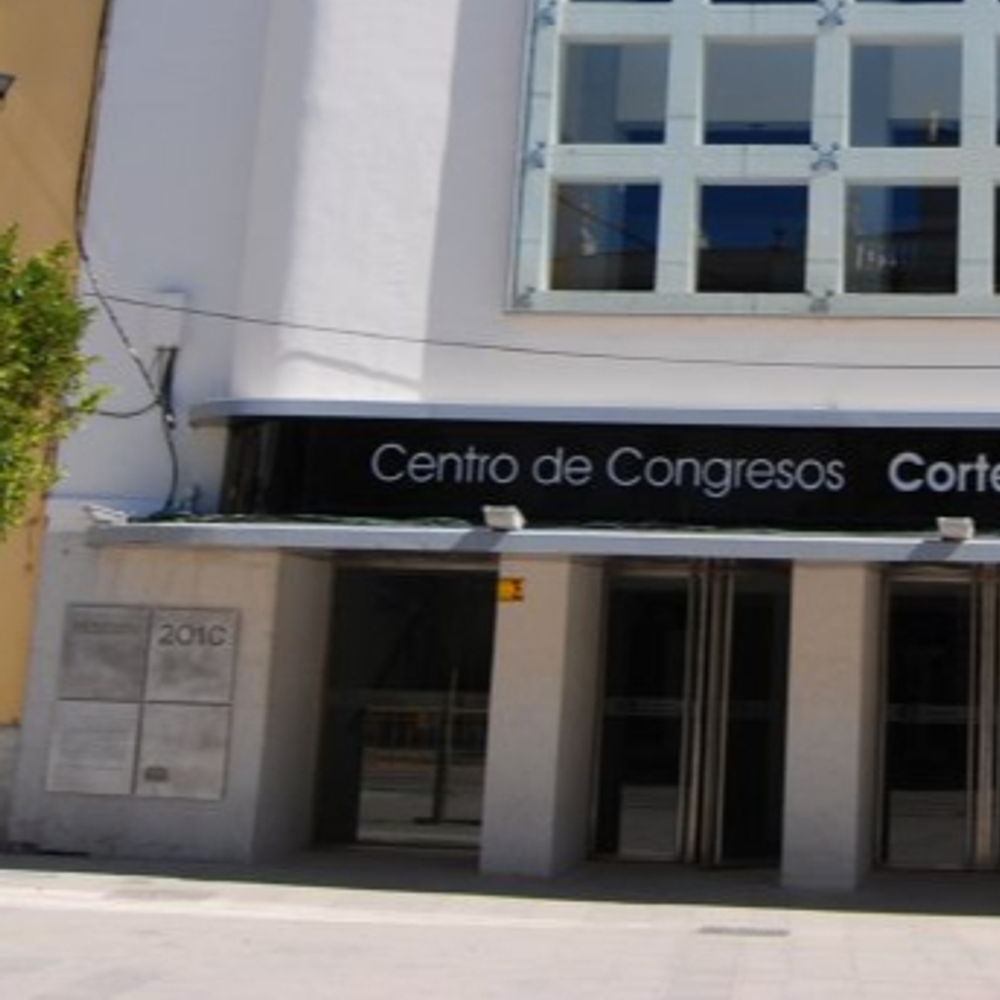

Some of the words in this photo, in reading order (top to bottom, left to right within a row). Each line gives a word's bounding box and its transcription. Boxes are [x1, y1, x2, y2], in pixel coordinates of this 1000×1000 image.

[370, 442, 521, 486] Centro
[533, 448, 593, 487] de
[606, 446, 846, 498] Congresos
